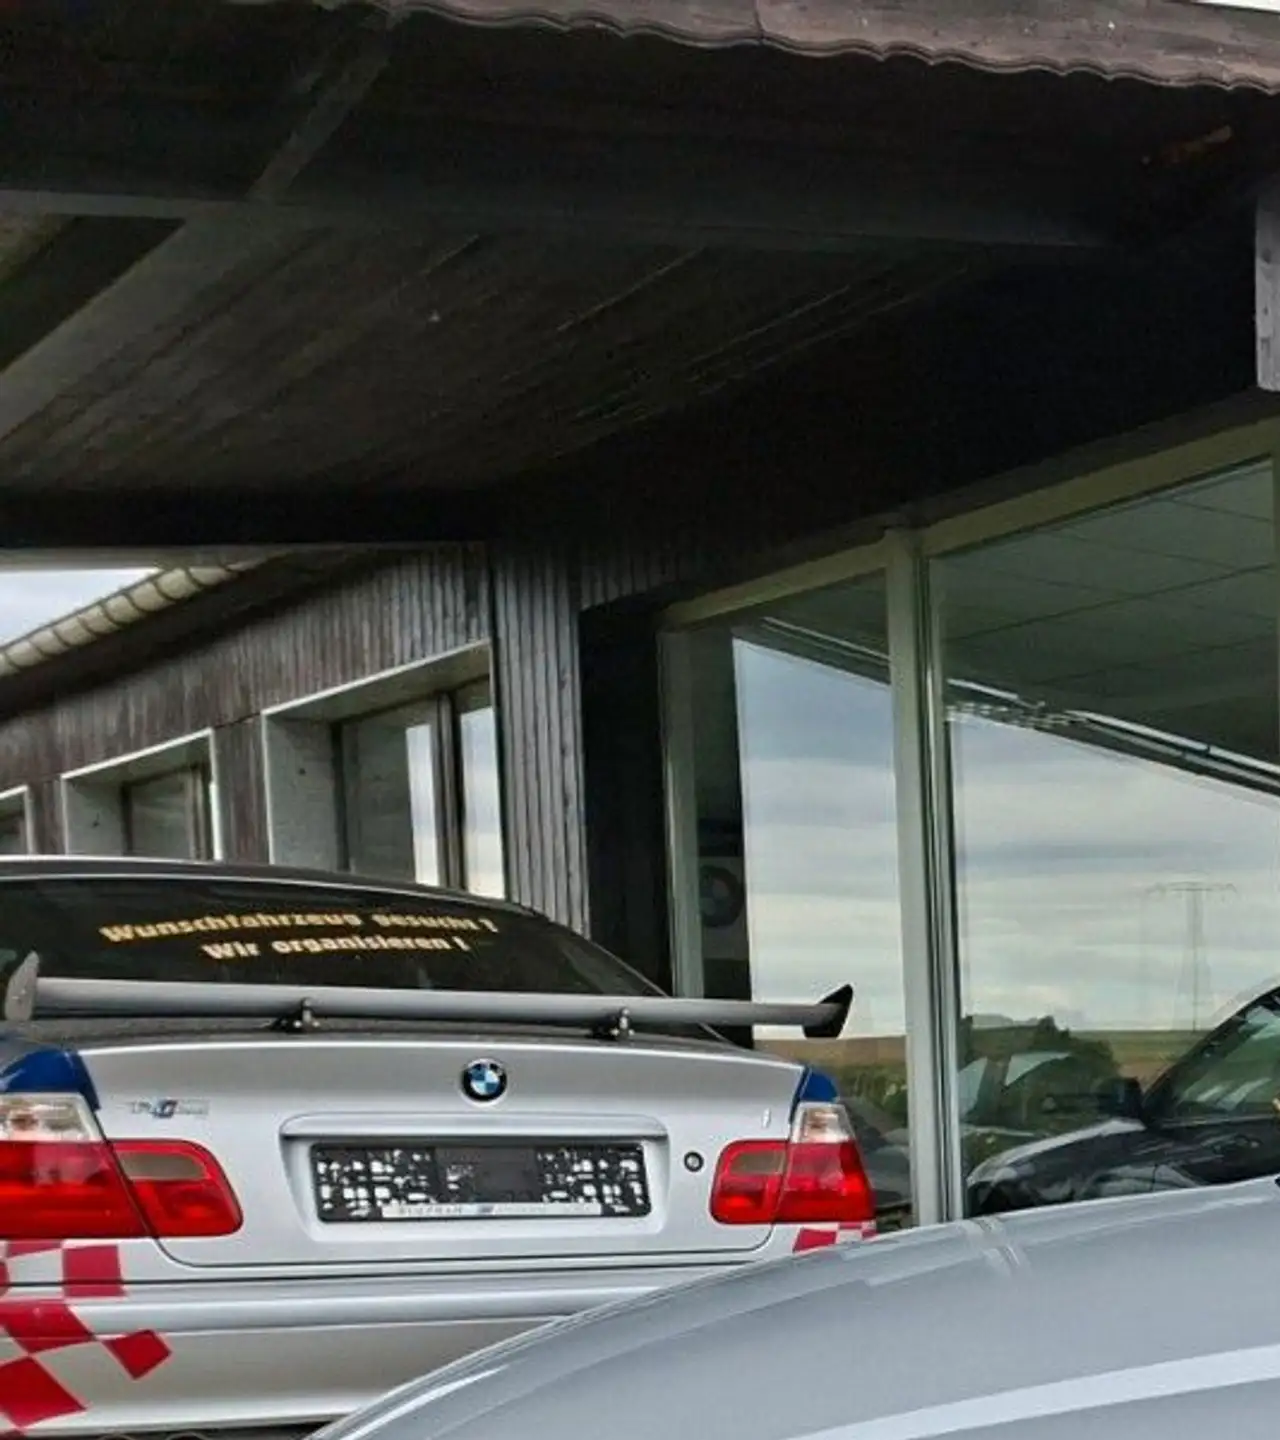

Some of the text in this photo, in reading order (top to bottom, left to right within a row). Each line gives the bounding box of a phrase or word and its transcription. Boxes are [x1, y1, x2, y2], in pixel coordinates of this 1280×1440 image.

[98, 912, 363, 942] Wunschfahrzeug
[201, 940, 261, 960] Wir
[270, 934, 453, 954] organisieren
